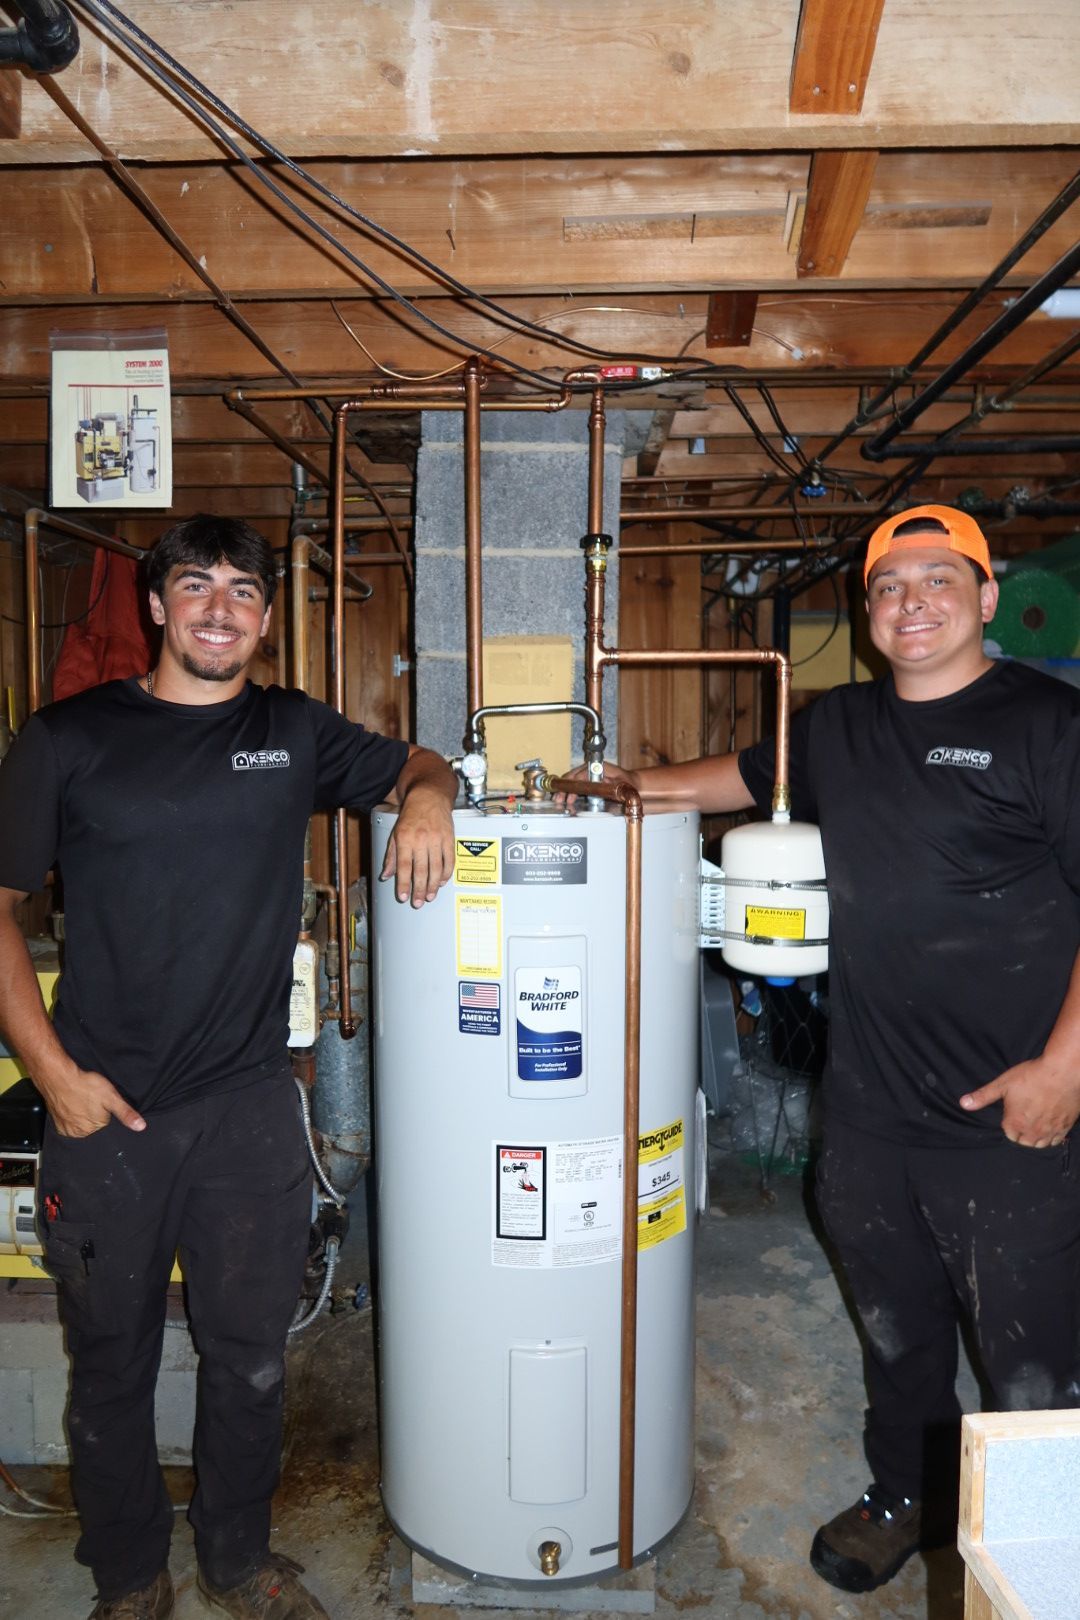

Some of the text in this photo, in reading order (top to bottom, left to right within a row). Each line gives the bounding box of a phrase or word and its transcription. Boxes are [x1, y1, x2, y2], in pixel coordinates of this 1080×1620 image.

[125, 360, 163, 368] SYSTEM 2000
[249, 752, 288, 763] KENCO
[943, 750, 990, 763] KENCO
[526, 845, 582, 858] KENCO
[519, 990, 579, 1001] BRADFORD
[530, 1001, 567, 1011] WHITE
[460, 1013, 499, 1023] AMERICA
[638, 1122, 682, 1150] NERGYGUIDE
[652, 1171, 671, 1187] $345
